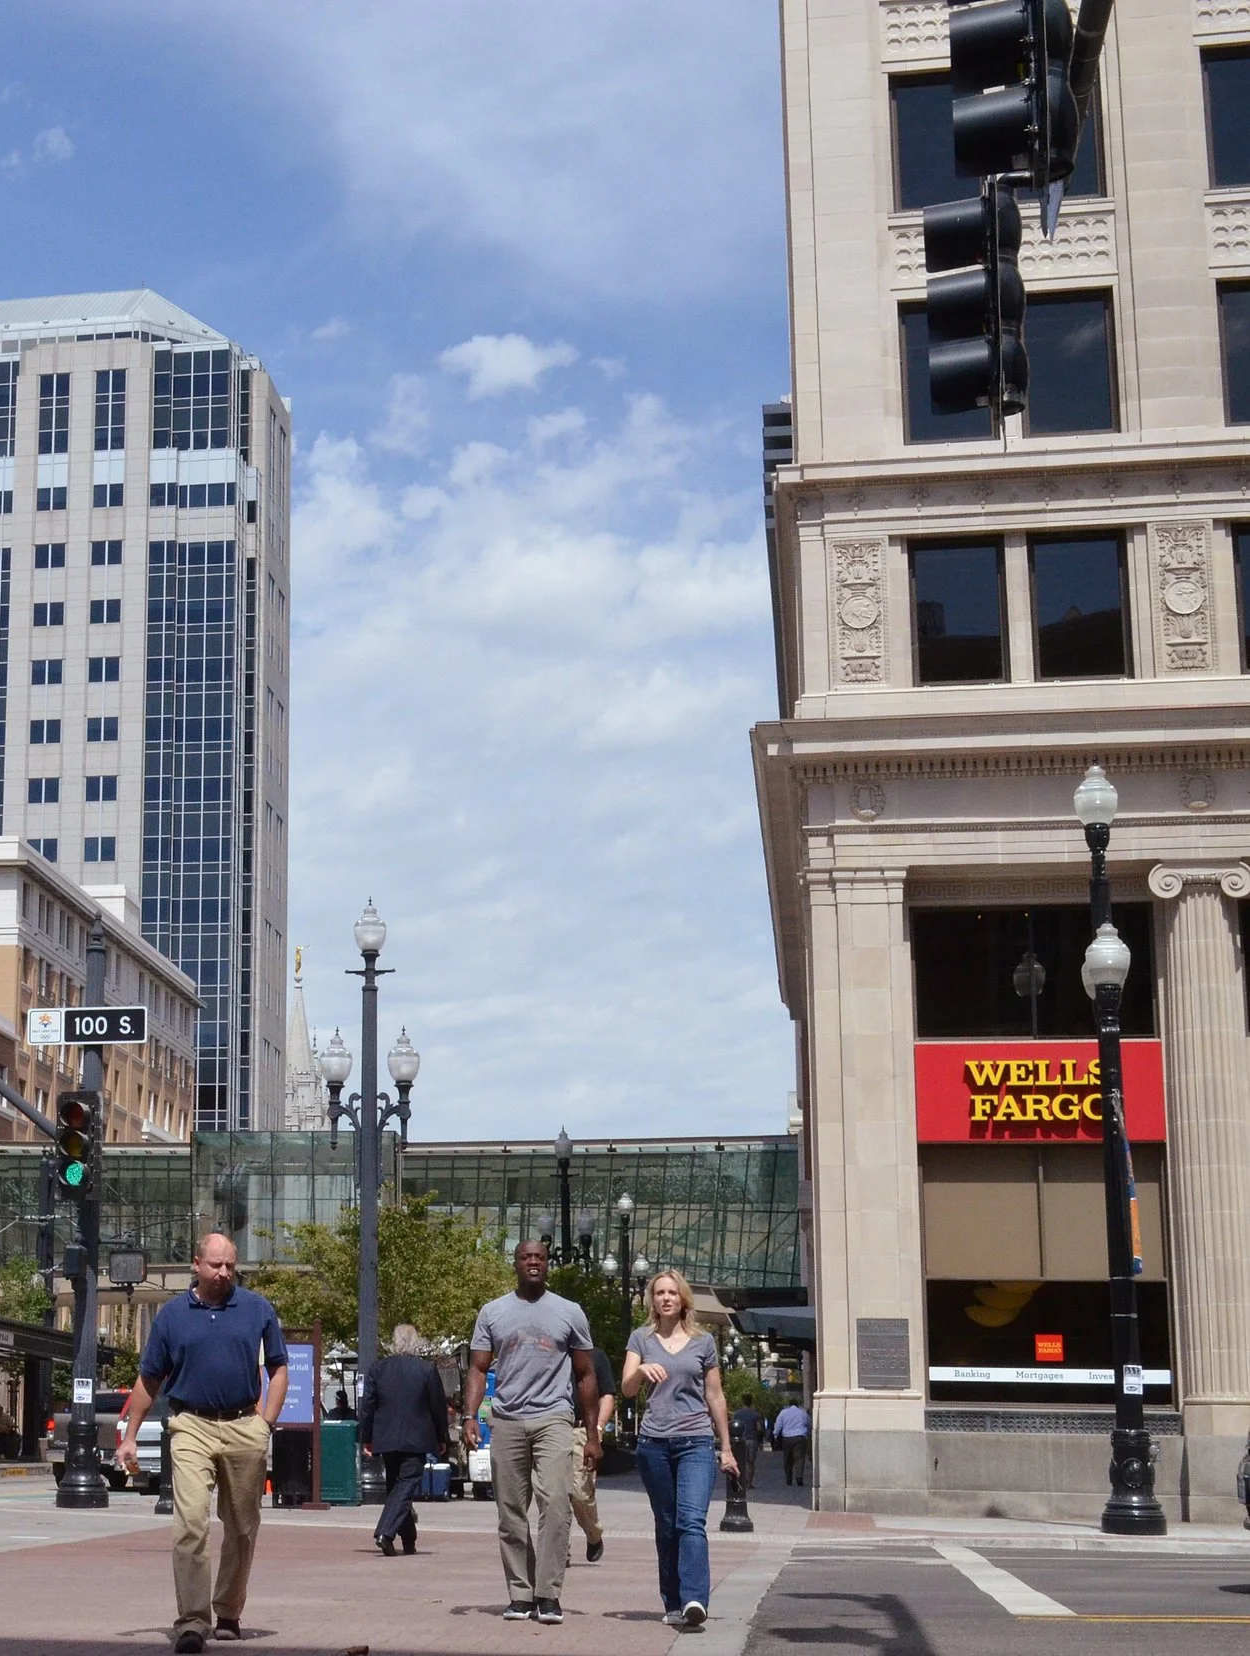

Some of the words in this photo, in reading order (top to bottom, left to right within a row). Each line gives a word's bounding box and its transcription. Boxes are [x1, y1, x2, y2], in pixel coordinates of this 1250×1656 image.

[74, 1016, 108, 1035] 100
[118, 1015, 135, 1035] S.
[970, 1093, 1103, 1121] FARGO
[954, 1369, 991, 1379] Banking
[1016, 1370, 1065, 1380] Mortgages
